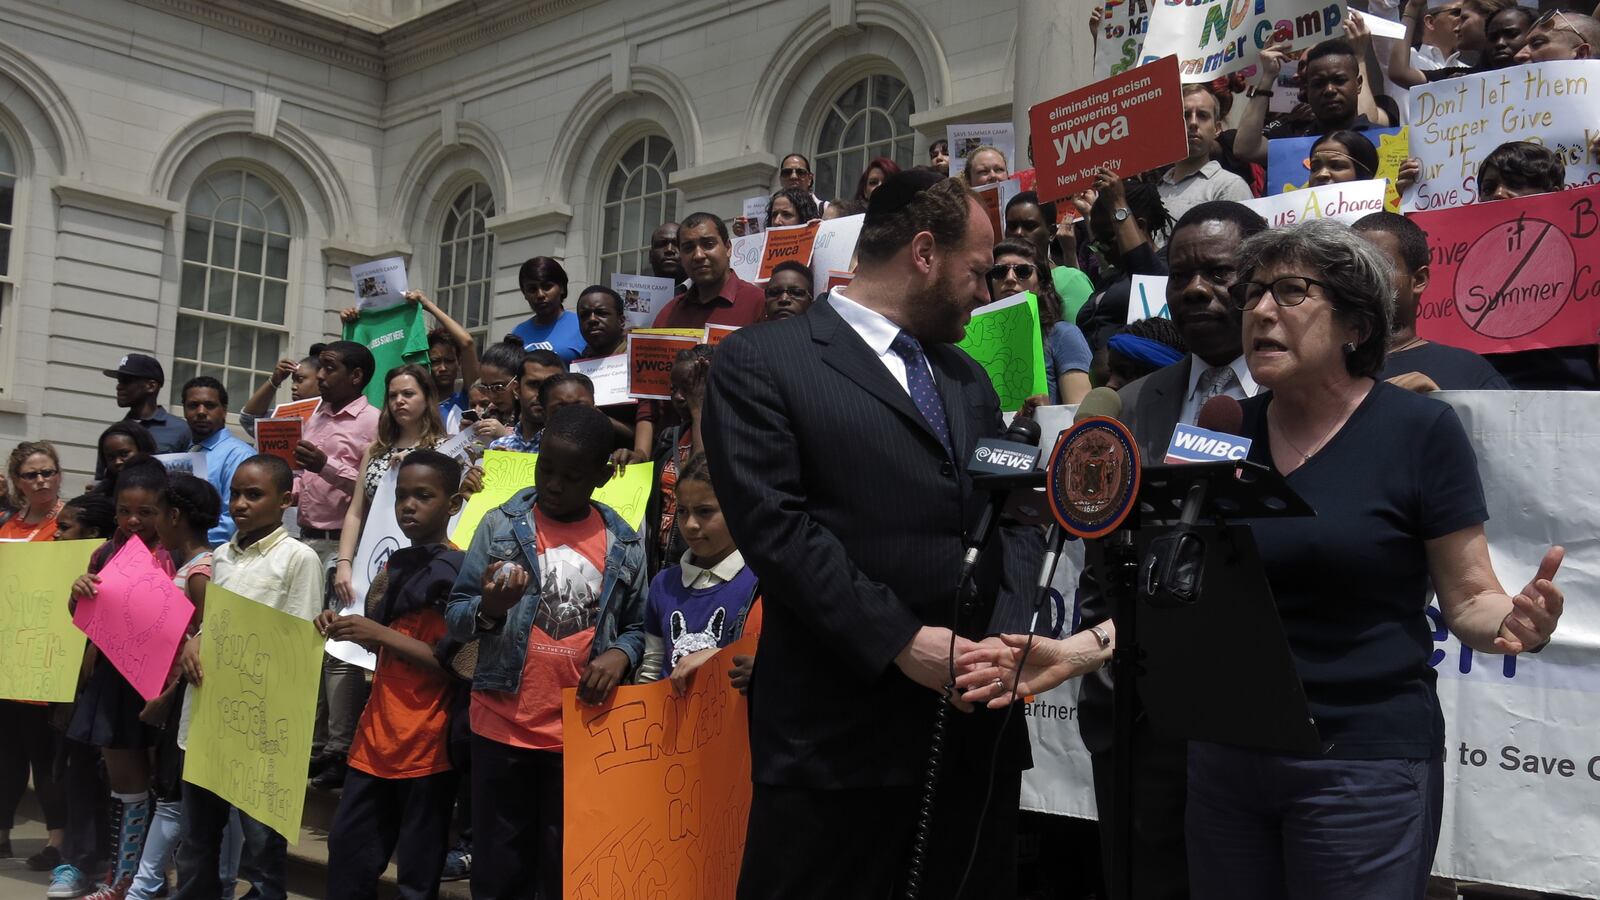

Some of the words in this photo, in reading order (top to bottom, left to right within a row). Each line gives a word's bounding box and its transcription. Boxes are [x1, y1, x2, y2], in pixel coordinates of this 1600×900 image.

[1049, 93, 1109, 120] eliminating
[1112, 77, 1151, 97] racism
[1051, 102, 1118, 133] empowering
[1121, 88, 1162, 109] women
[1415, 82, 1468, 127] Don't
[1480, 74, 1511, 109] let
[1524, 69, 1588, 100] them
[1052, 115, 1129, 166] ywca
[1424, 119, 1490, 158] Suffer
[1502, 105, 1552, 133] Give
[1057, 173, 1077, 187] New
[1080, 166, 1100, 178] York
[1102, 159, 1122, 171] City
[1275, 210, 1296, 225] us
[1301, 191, 1323, 222] A
[1325, 191, 1382, 217] chance
[1415, 183, 1458, 211] Save
[768, 244, 799, 261] ywca
[1465, 281, 1564, 312] Summer
[636, 359, 672, 374] ywca
[987, 452, 1033, 470] NEWS
[1174, 431, 1246, 460] WMBC
[1024, 700, 1079, 721] artner
[1459, 742, 1487, 767] to
[1499, 745, 1576, 778] Save
